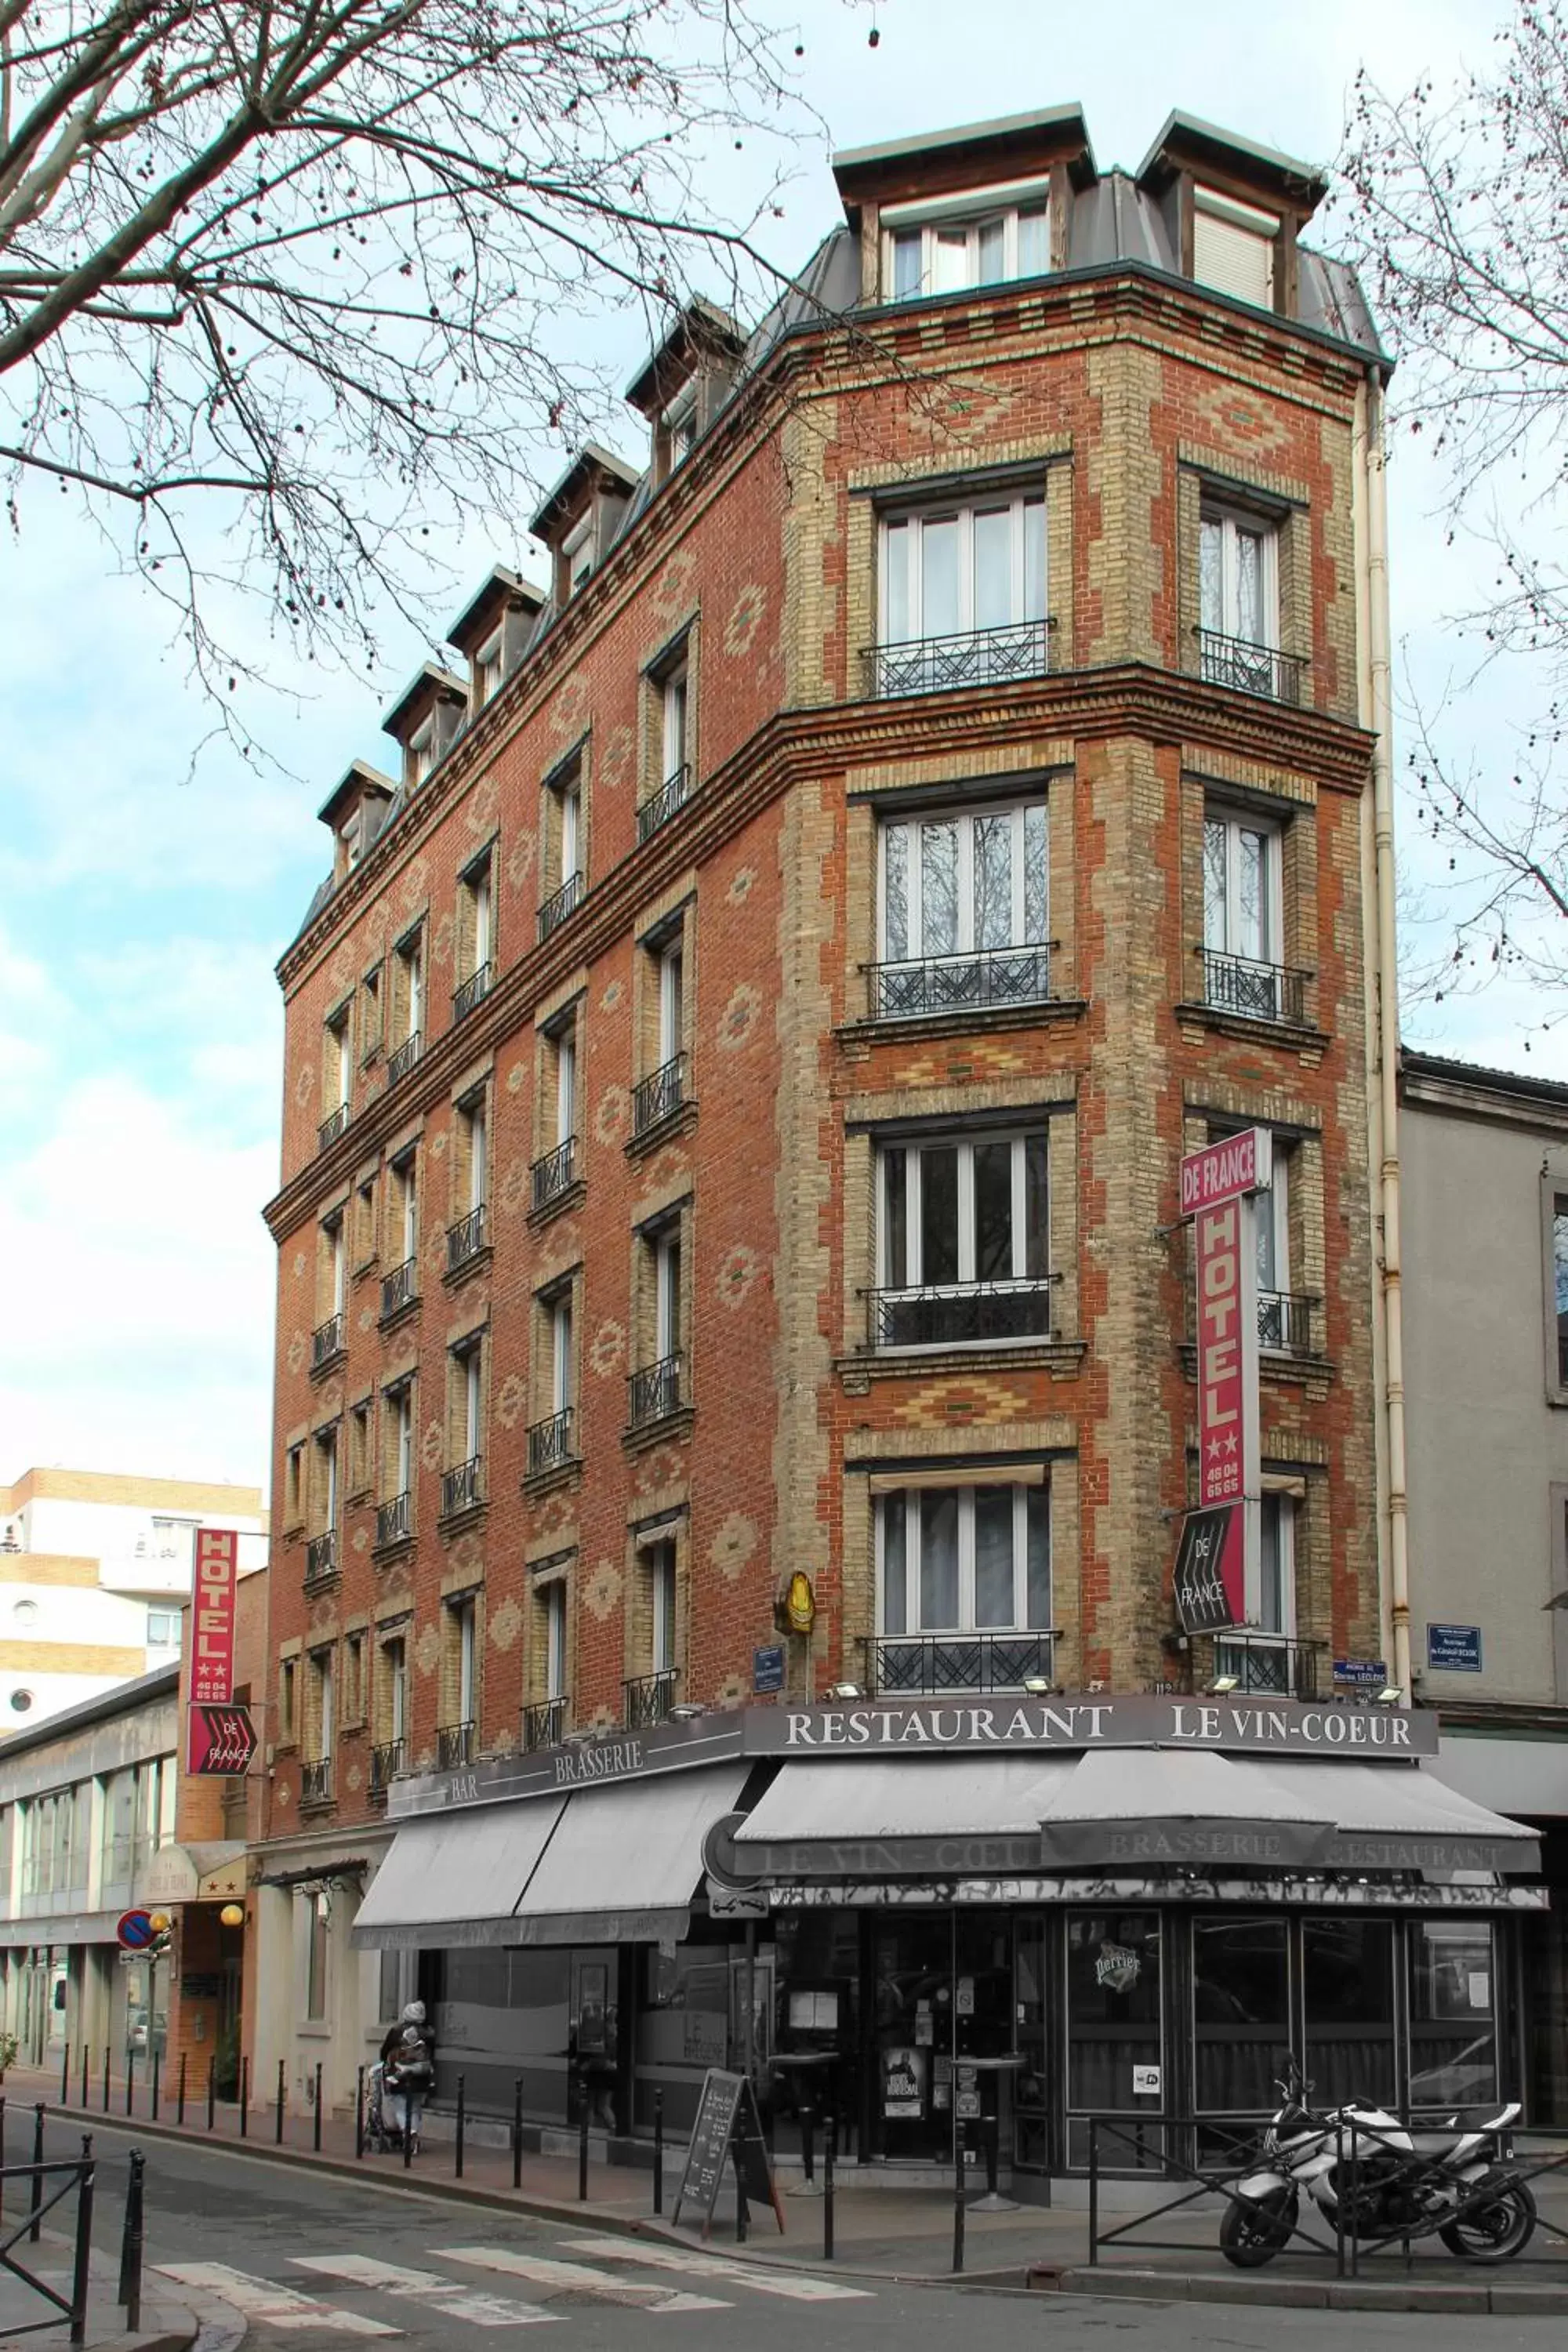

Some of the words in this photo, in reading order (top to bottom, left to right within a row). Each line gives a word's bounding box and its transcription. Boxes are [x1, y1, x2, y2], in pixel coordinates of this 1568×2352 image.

[1183, 1162, 1200, 1205] DE
[1203, 1141, 1254, 1197] FRANCE
[1204, 1208, 1239, 1429] HOTEL
[1196, 1537, 1210, 1559] DE
[198, 1532, 232, 1659] HOTEL
[1181, 1581, 1223, 1606] FRANCE
[223, 1722, 238, 1735] DE
[786, 1704, 1112, 1745] RESTAURANT
[1171, 1704, 1223, 1739] LE
[1231, 1708, 1411, 1745] VIN-COEUR
[209, 1747, 251, 1762] FRANCE
[555, 1740, 644, 1784] BRASSERIE
[452, 1774, 478, 1802] BAR
[763, 1845, 812, 1872] LE
[828, 1842, 905, 1871] VIN
[1107, 1831, 1281, 1857] BRASSERIE
